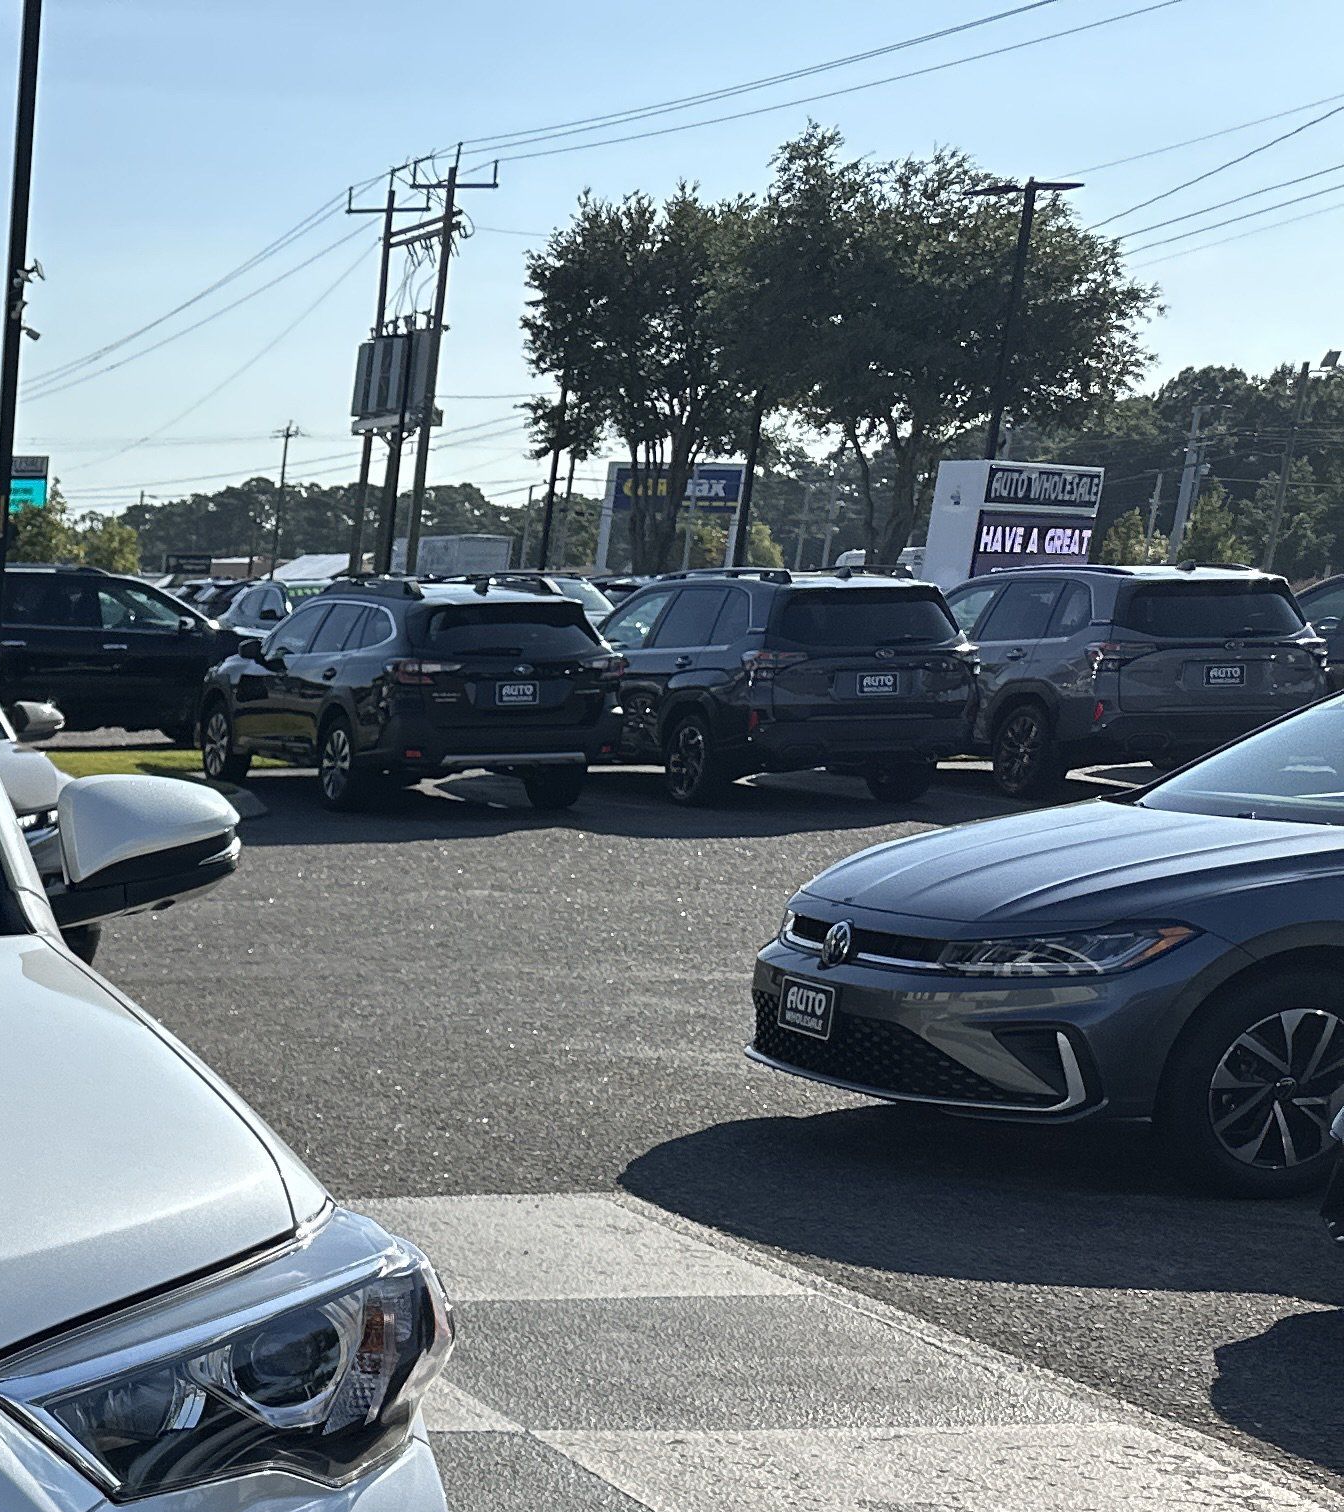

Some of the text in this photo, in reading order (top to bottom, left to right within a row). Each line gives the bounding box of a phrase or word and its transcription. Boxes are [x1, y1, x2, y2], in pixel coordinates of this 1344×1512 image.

[991, 470, 1100, 503] AUTO WHOLESALE
[979, 525, 1093, 556] HAVE A GREAT
[863, 675, 894, 687] AUTO
[1210, 667, 1241, 678] AUTO
[502, 684, 534, 696] AUTO
[787, 986, 827, 1016] AUTO
